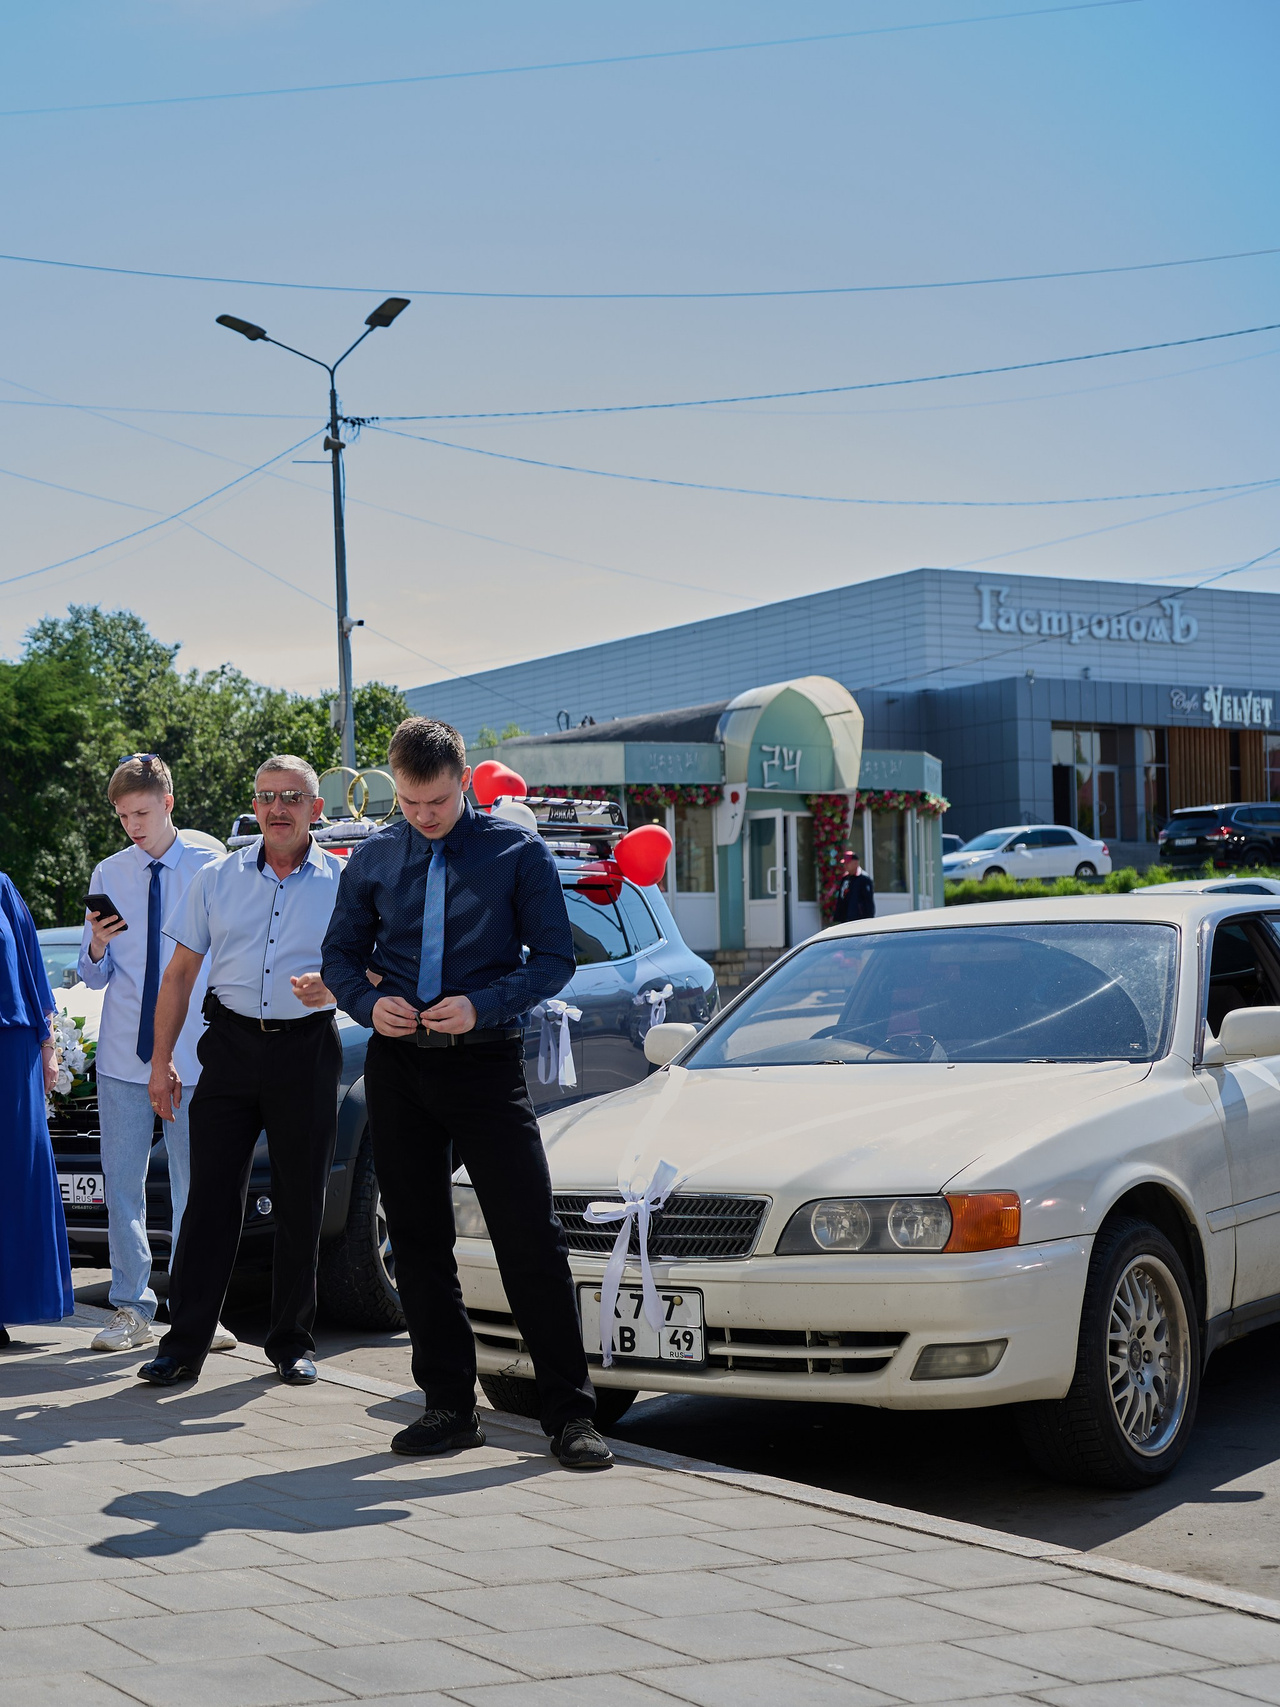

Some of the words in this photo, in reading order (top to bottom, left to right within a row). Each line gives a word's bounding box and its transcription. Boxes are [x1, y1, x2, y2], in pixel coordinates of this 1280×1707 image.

[1203, 684, 1272, 728] VELVET
[76, 1177, 97, 1195] 49
[669, 1329, 694, 1351] 49
[669, 1351, 685, 1359] RUS
